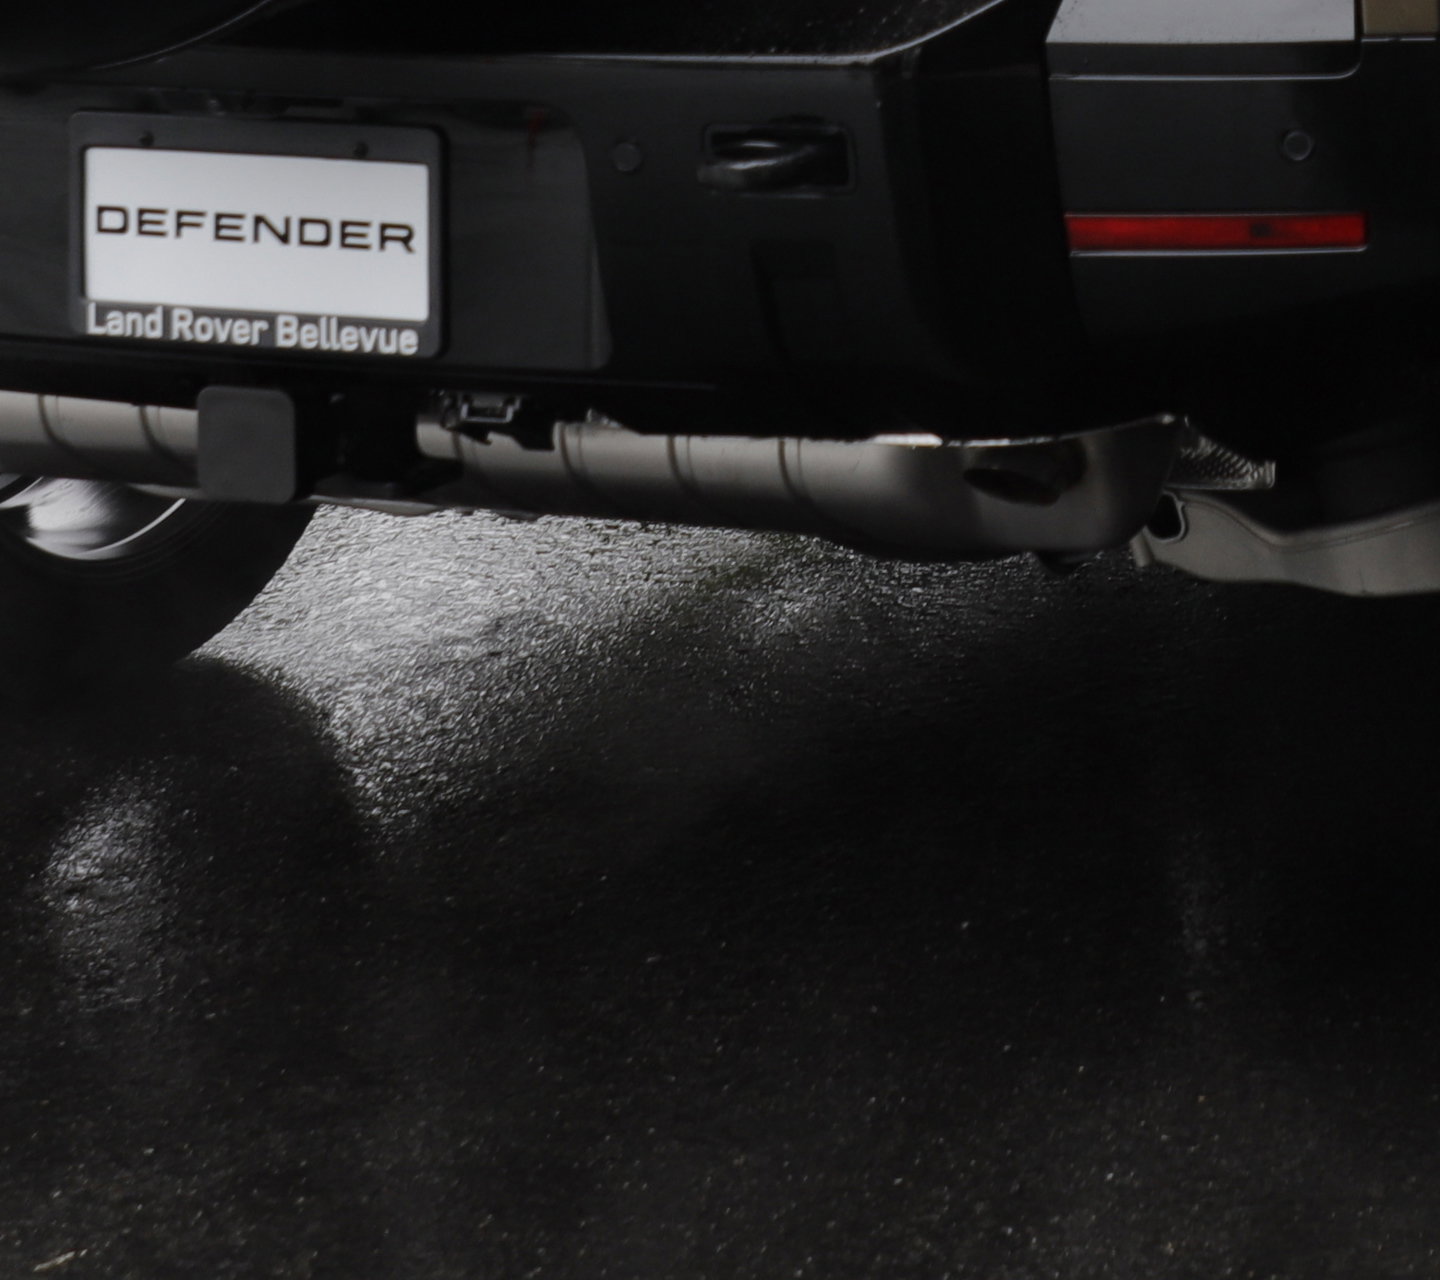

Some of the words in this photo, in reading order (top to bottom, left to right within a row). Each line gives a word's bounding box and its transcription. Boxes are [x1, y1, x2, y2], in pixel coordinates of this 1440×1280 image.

[96, 205, 416, 253] DEFENDER
[87, 302, 163, 338] Land
[172, 308, 268, 346] Rover
[276, 314, 419, 355] Bellevue
